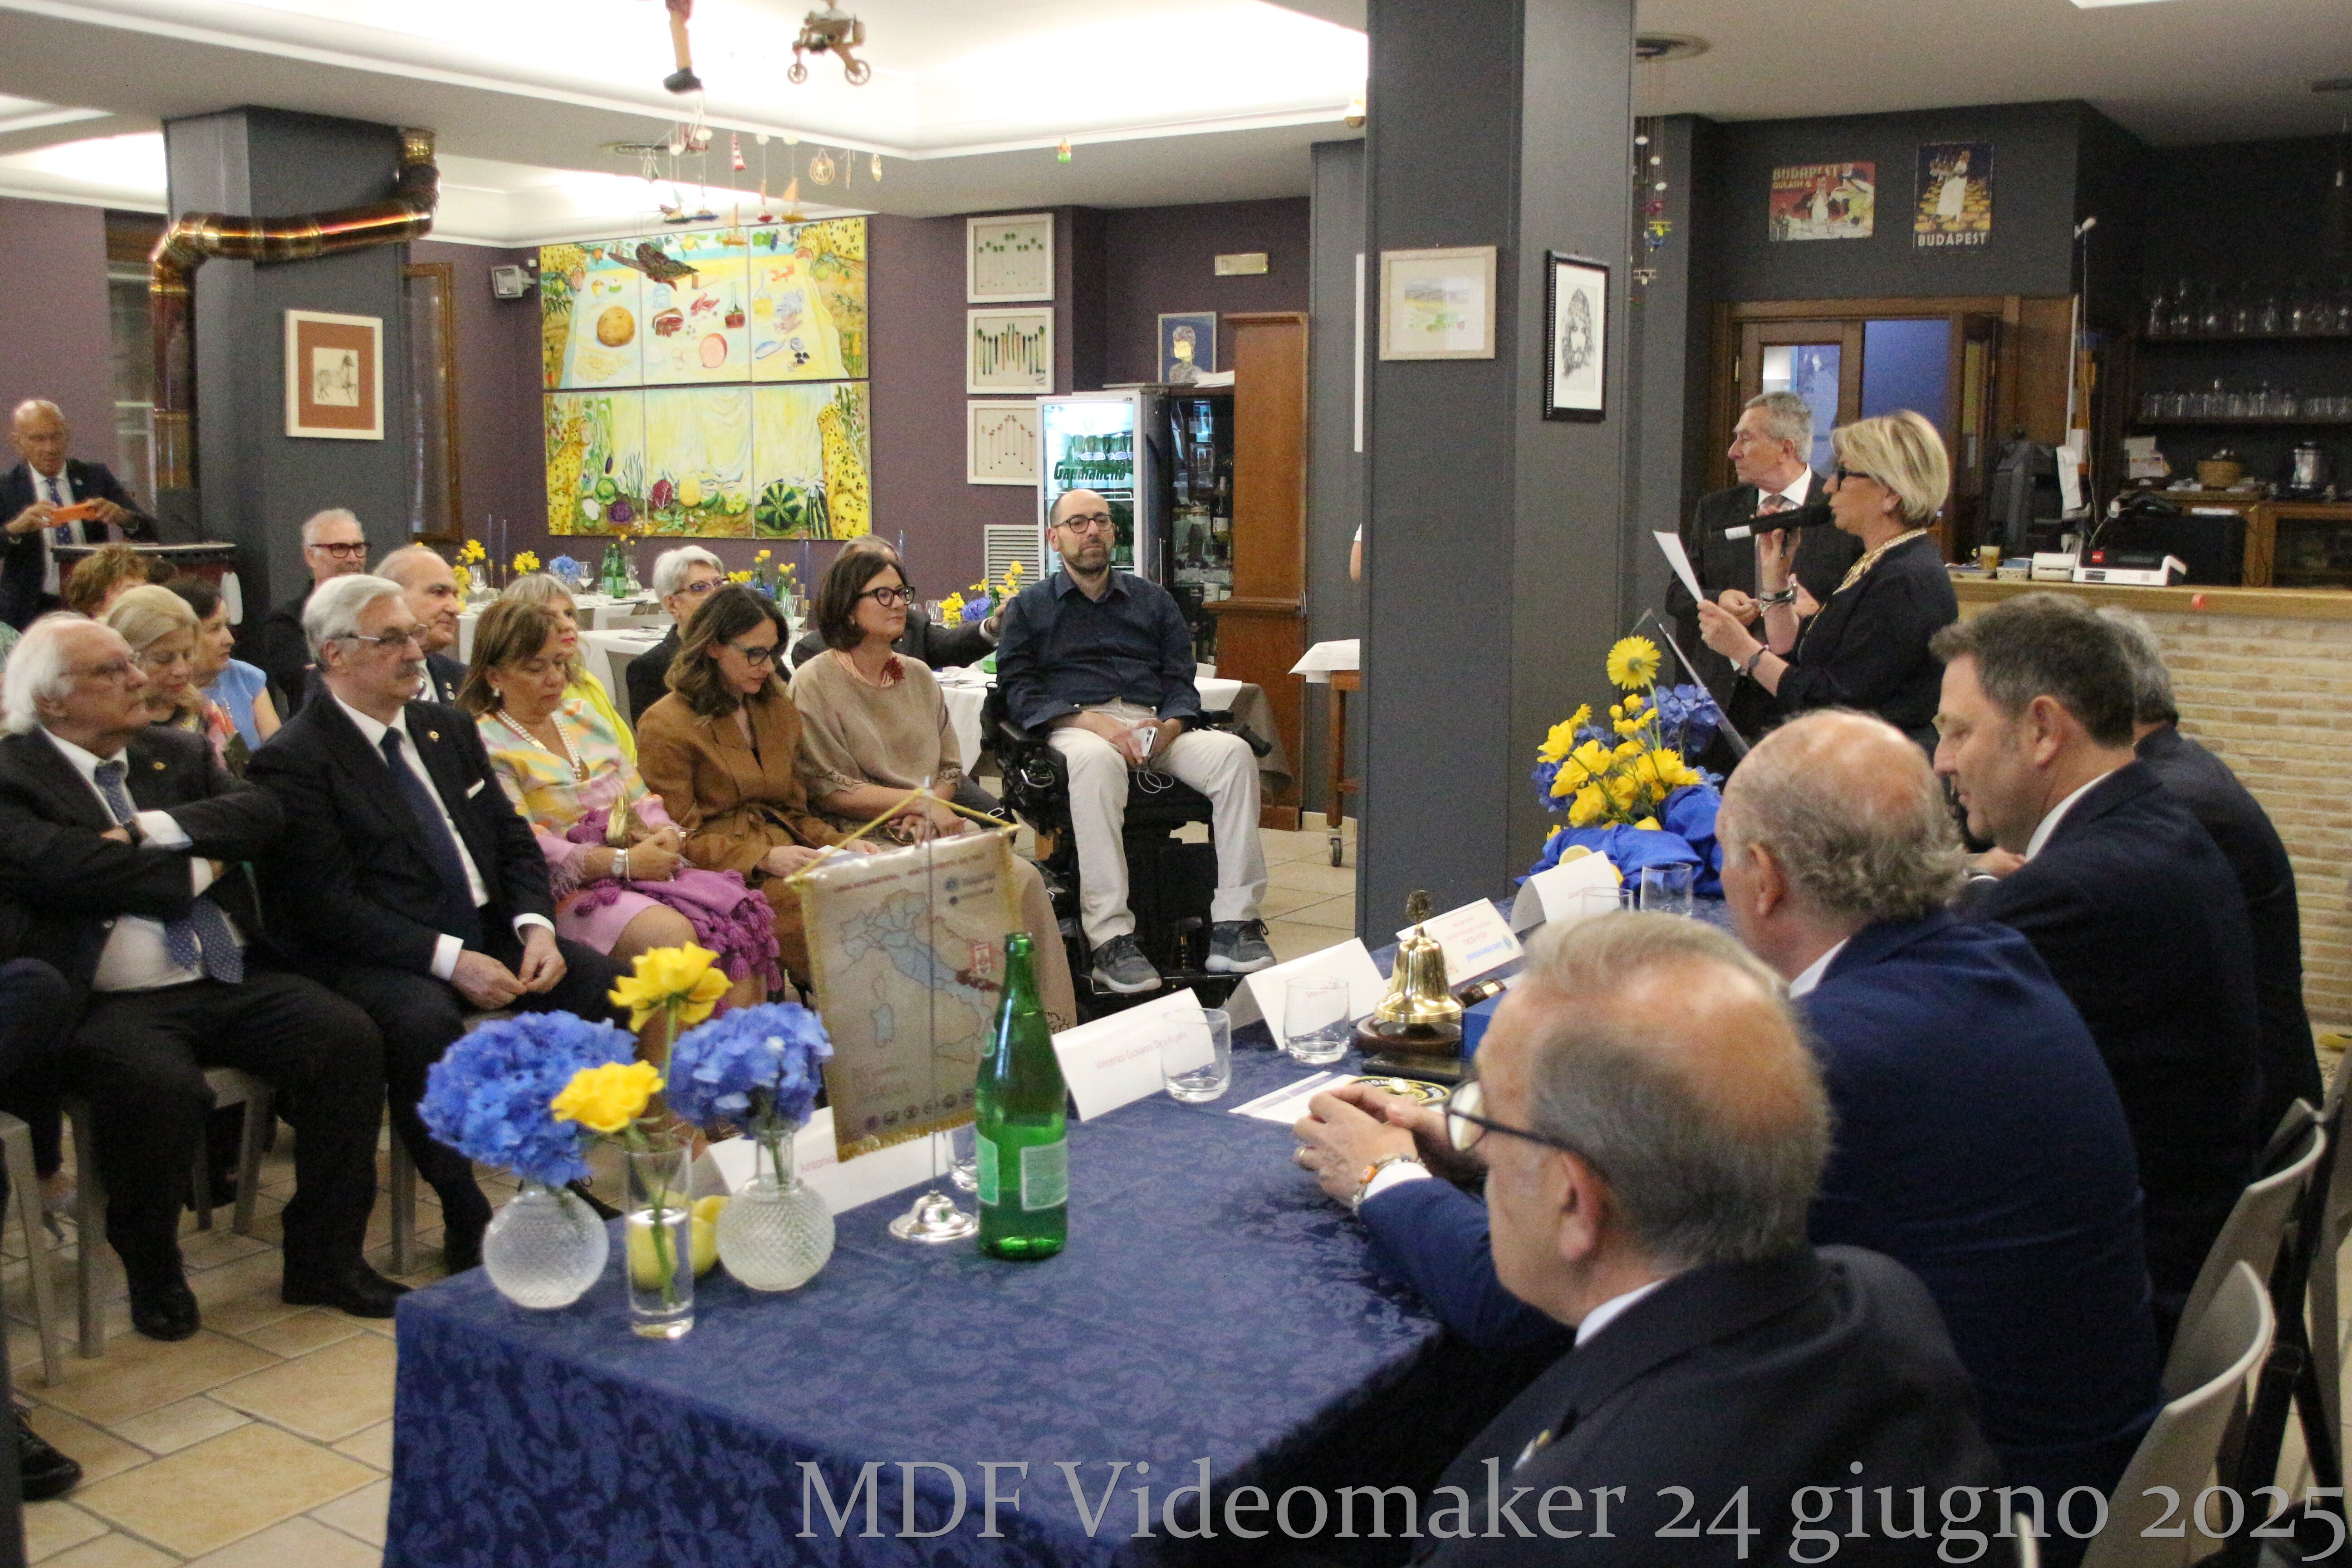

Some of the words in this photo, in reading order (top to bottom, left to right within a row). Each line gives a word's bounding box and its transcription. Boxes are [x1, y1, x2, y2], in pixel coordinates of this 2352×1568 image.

[1917, 231, 1987, 246] BUDAPEST
[1095, 1054, 1126, 1069] Vincenzo
[1126, 1044, 1154, 1059] Giovanni
[800, 1155, 836, 1173] Antonio
